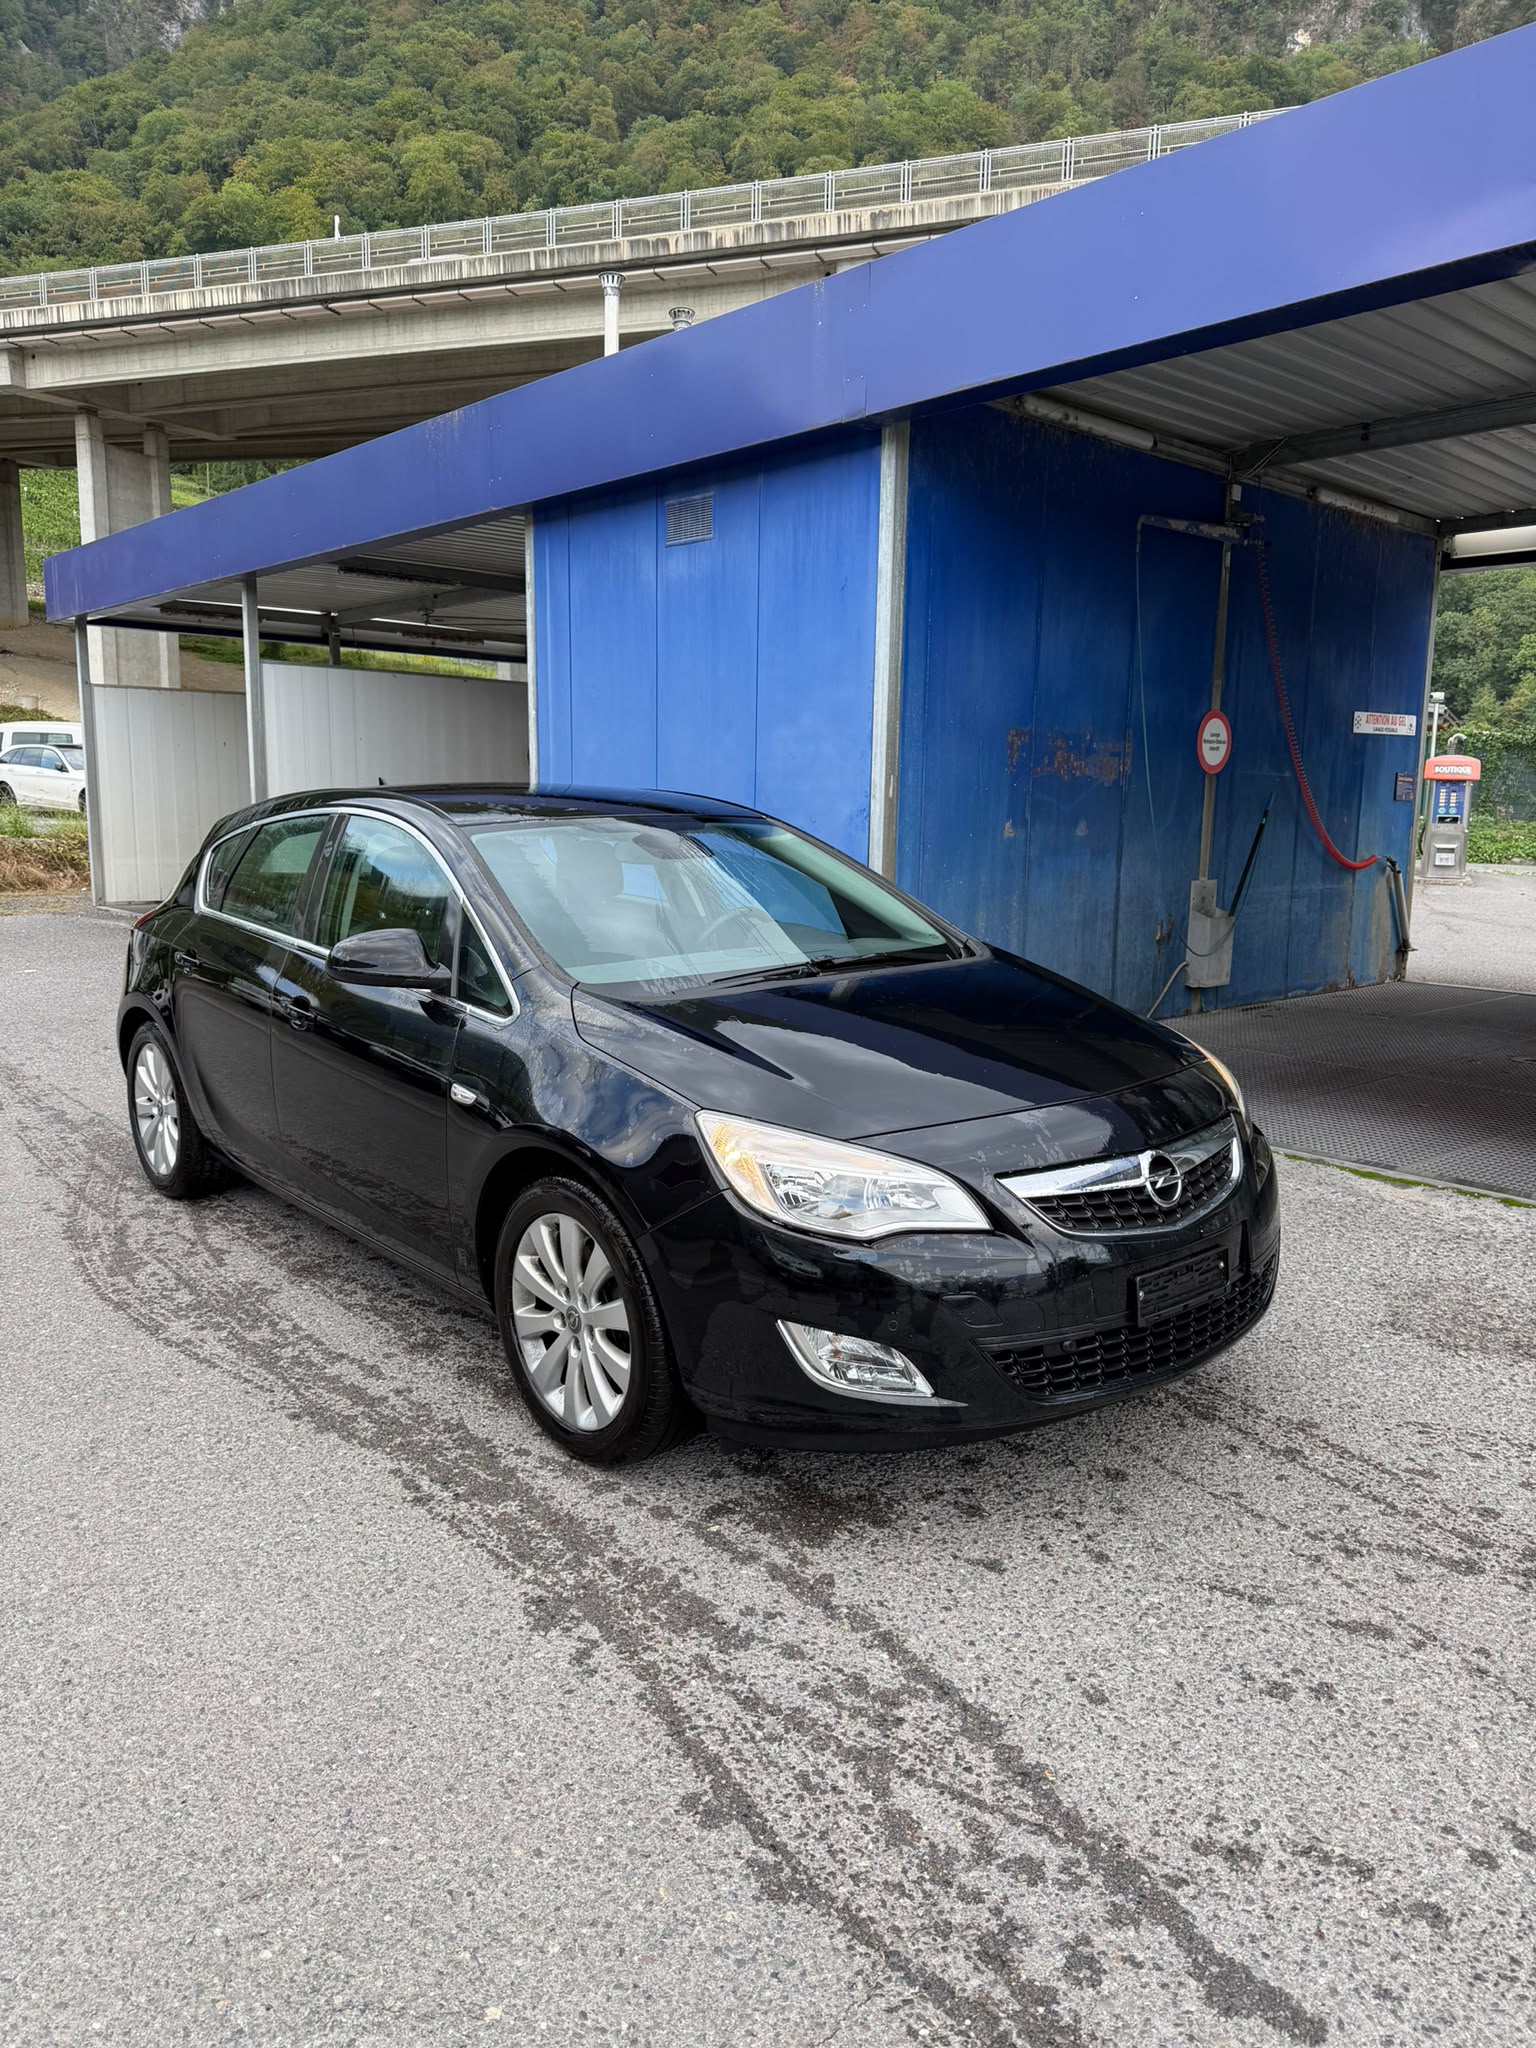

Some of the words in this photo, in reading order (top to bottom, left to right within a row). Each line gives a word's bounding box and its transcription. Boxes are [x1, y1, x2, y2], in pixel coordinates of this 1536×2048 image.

[1365, 713, 1390, 726] ATTENTION
[1391, 715, 1398, 726] AU
[1398, 716, 1407, 727] GEL
[1434, 765, 1472, 776] BOUTIQUE
